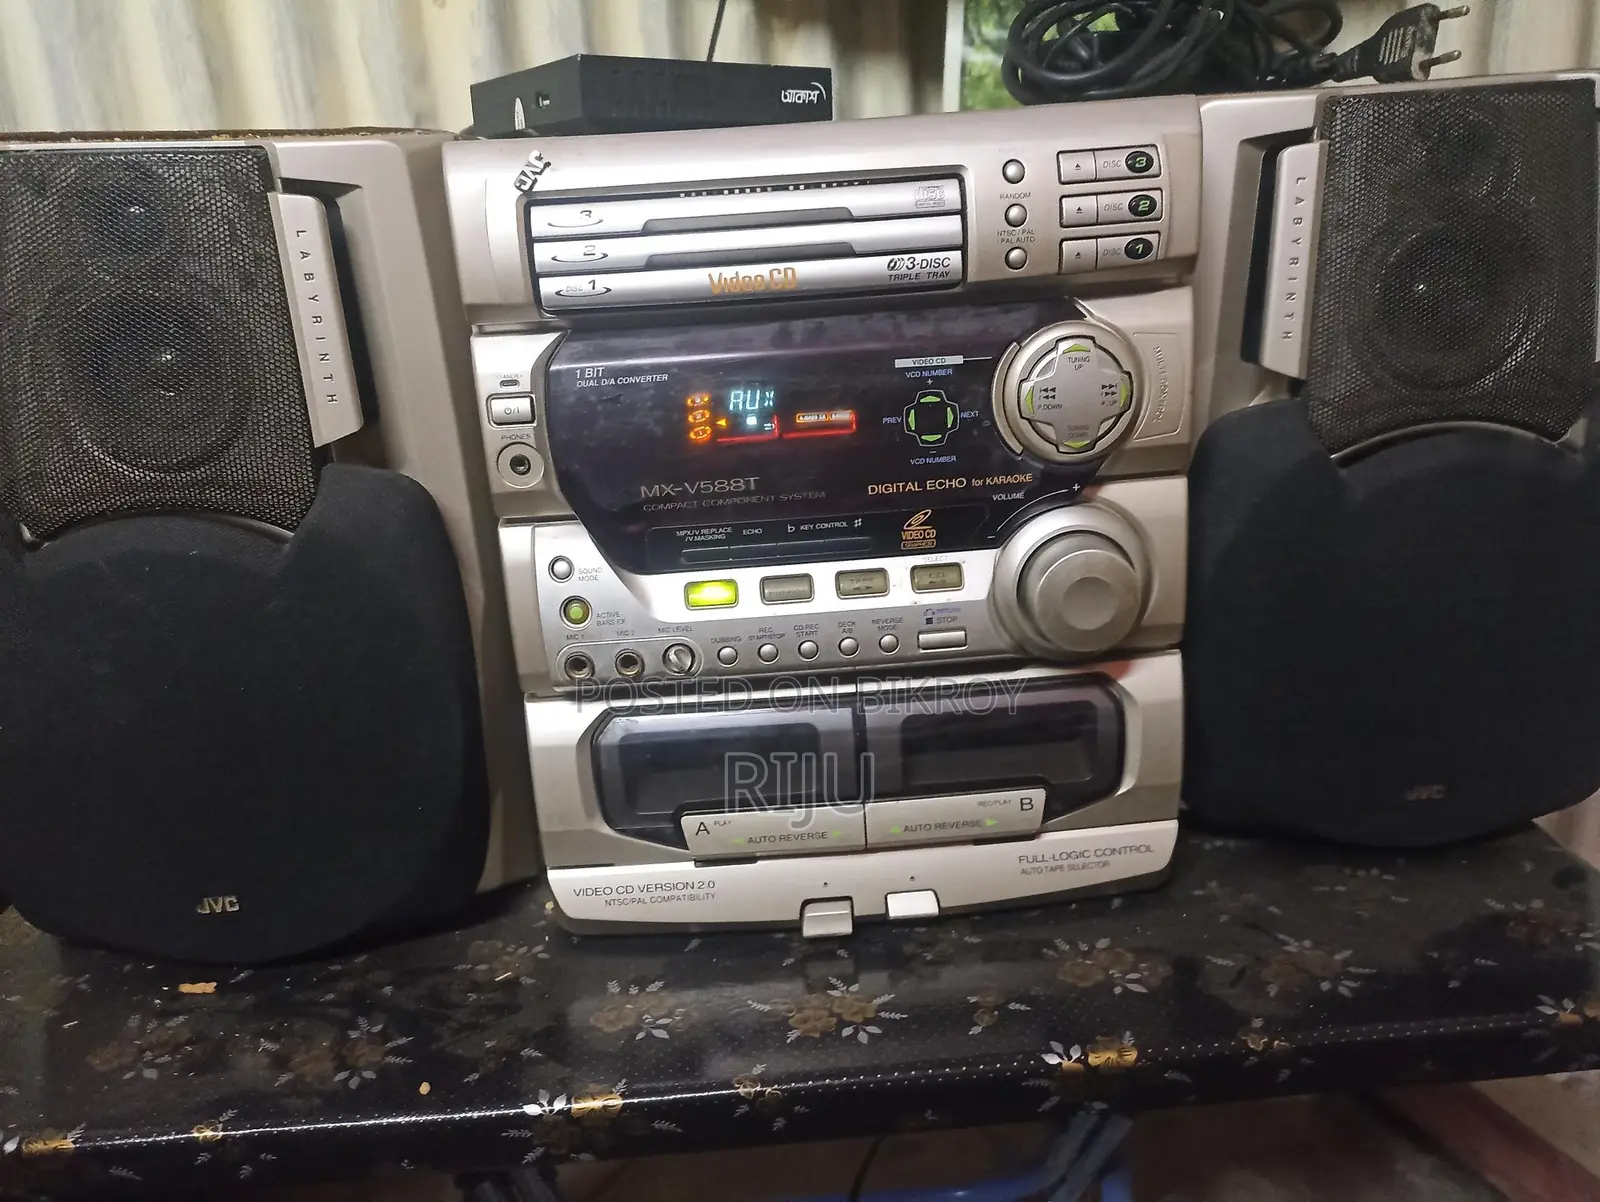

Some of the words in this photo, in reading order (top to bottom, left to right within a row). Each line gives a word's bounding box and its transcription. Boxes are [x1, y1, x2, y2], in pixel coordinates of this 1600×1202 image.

[781, 89, 820, 104] আকাশ
[1103, 160, 1122, 169] DISC
[1135, 157, 1148, 167] 3
[514, 150, 551, 192] JVC
[1000, 192, 1031, 200] RANDOM
[1104, 202, 1123, 212] DISC
[1137, 200, 1151, 211] 2
[579, 209, 592, 219] 3
[583, 244, 596, 256] 2
[1103, 246, 1121, 256] DISC
[1135, 243, 1144, 254] 1
[905, 256, 951, 270] 3-DISC
[1282, 177, 1307, 340] LABYRINTH
[708, 270, 765, 294] Video
[768, 266, 798, 291] CD
[888, 273, 921, 281] TRIPLE
[926, 271, 951, 279] TRAY
[588, 279, 596, 291] 1
[296, 229, 338, 404] LABYRINTH
[1068, 356, 1090, 364] TUNING
[584, 366, 605, 378] BIT
[922, 369, 953, 377] NUMBER
[576, 378, 600, 388] DUAL
[601, 377, 616, 387] D/A
[617, 374, 668, 385] CONVERTER
[729, 389, 775, 411] AUX
[882, 416, 902, 424] PREV
[961, 410, 979, 418] NEXT
[926, 456, 956, 464] NUMBER
[640, 476, 760, 498] MX-V588T
[867, 480, 923, 495] DIGITAL
[926, 477, 967, 491] ECHO
[971, 476, 984, 487] for
[985, 472, 1033, 485] KARAOKE
[642, 501, 698, 512] COMPACT
[703, 495, 775, 507] COMPONENT
[780, 490, 826, 500] SYSTEM
[992, 492, 1025, 501] VOLUME
[800, 523, 813, 531] KEY
[815, 521, 848, 529] CONTROL
[901, 530, 924, 540] VIDEO
[925, 529, 936, 538] CD
[838, 620, 856, 628] DECK
[872, 617, 903, 625] REVERSE
[936, 616, 958, 624] STOP
[1020, 798, 1034, 811] B
[695, 822, 710, 836] A
[903, 822, 932, 832] AUTO
[934, 819, 983, 830] REVERSE
[747, 834, 776, 844] AUTO
[779, 831, 828, 842] REVERSE
[1018, 850, 1091, 864] FULL-LOGIC
[1094, 845, 1155, 858] CONTROL
[1020, 867, 1042, 875] AUTO
[1044, 865, 1066, 873] TAPE
[1067, 861, 1110, 871] SELECTOR
[573, 886, 613, 897] VIDEO
[616, 884, 634, 895] CD
[637, 881, 695, 893] VERSION
[697, 880, 715, 890] 2.0
[649, 892, 716, 904] COMPATIBILITY
[196, 896, 240, 913] JVC
